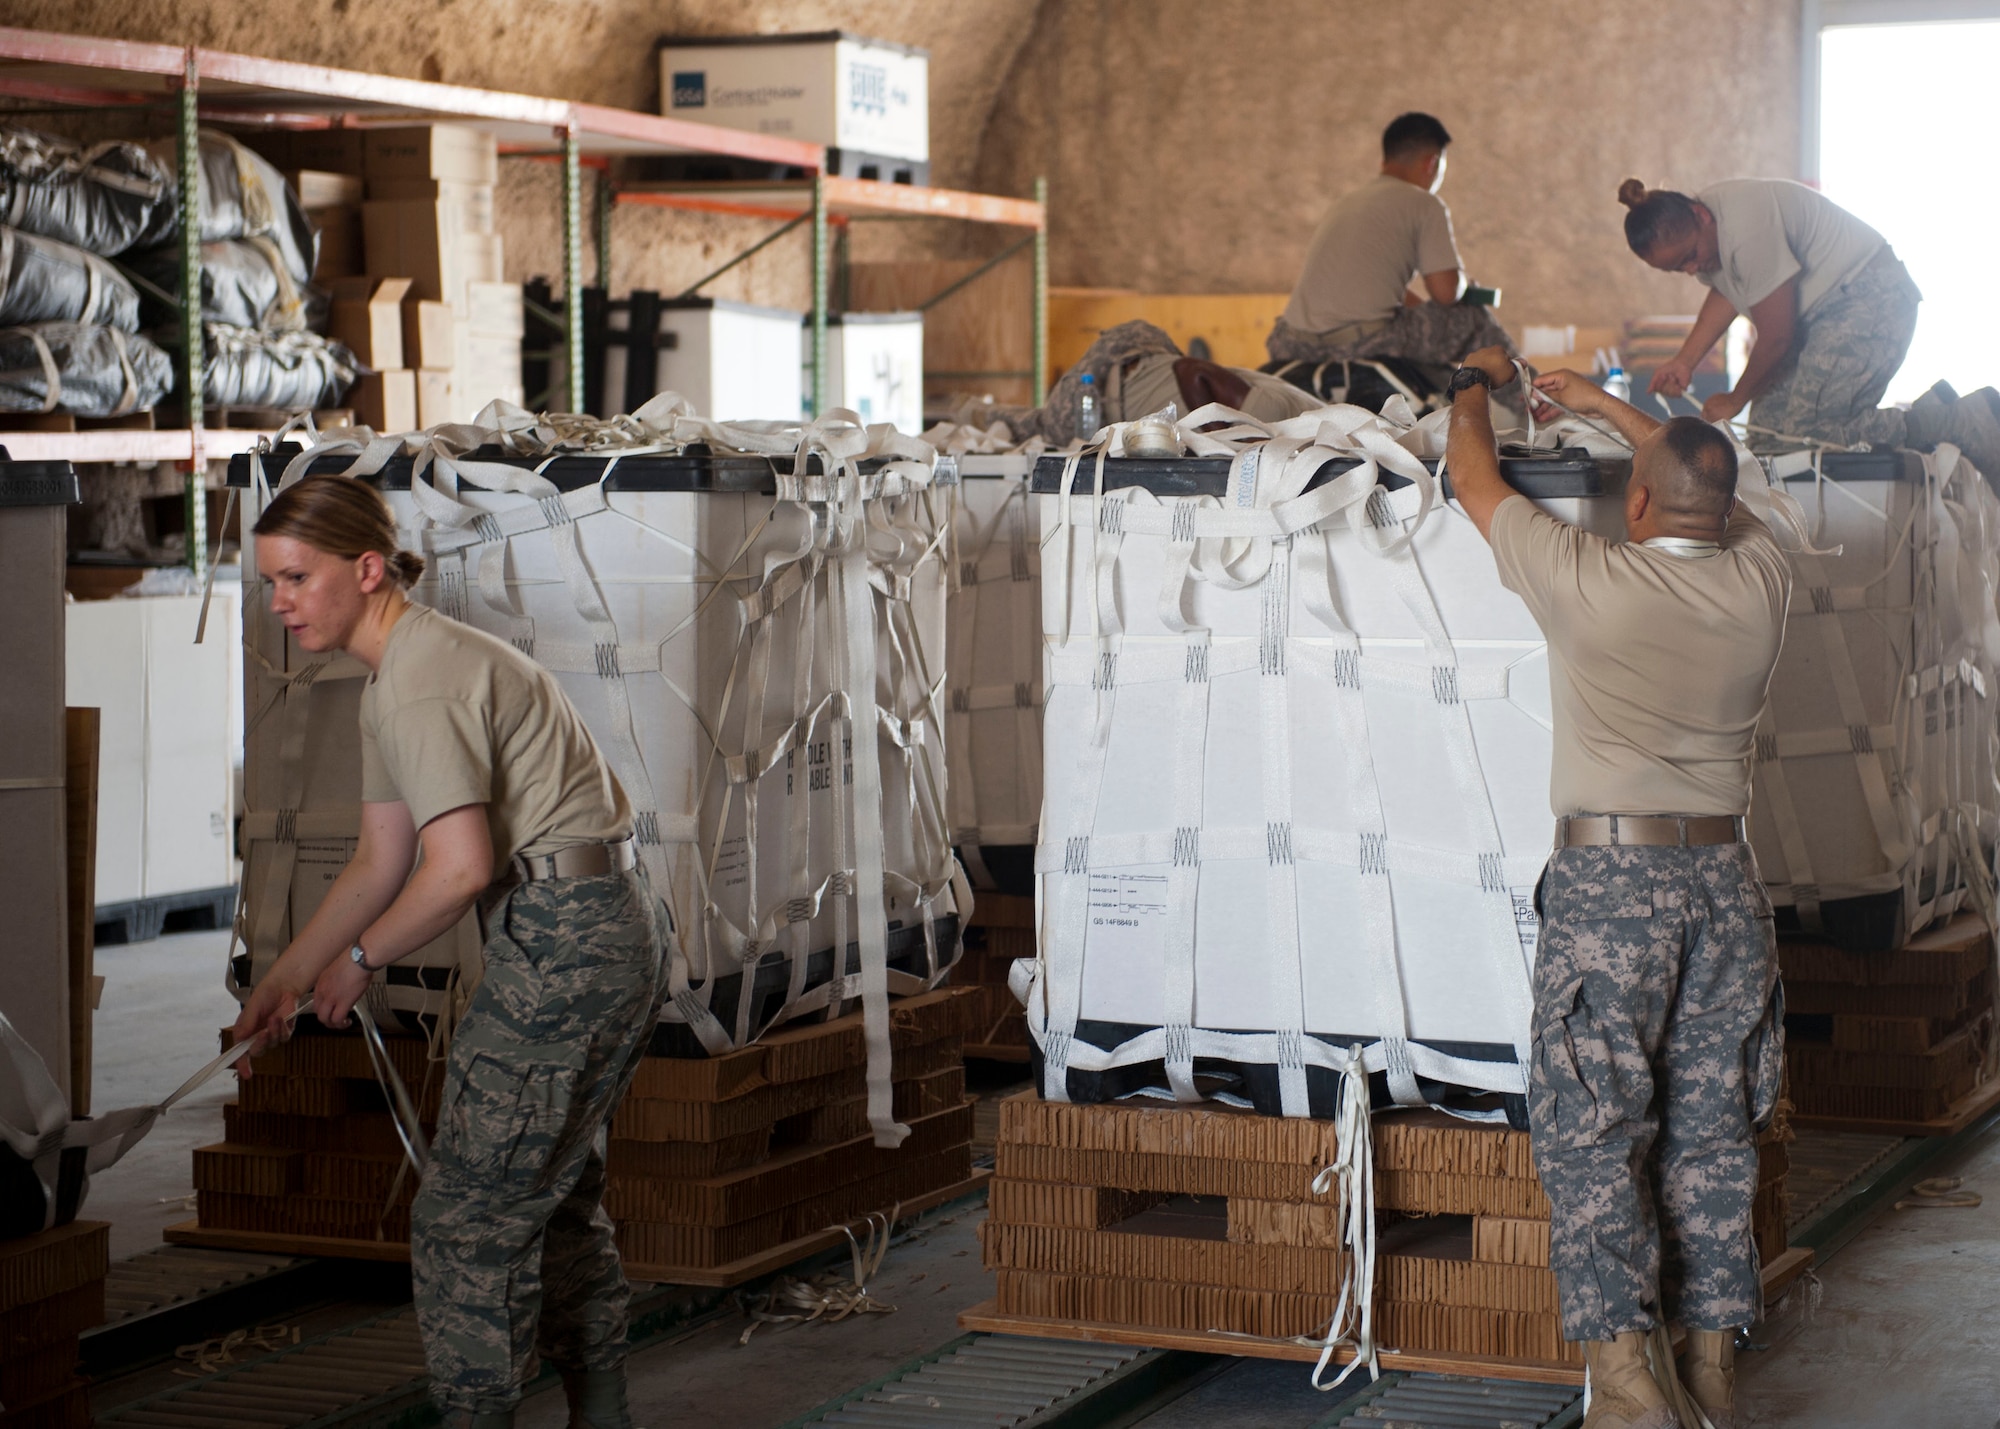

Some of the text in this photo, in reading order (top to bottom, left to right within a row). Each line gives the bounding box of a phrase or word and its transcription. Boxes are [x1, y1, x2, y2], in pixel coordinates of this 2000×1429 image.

[787, 742, 825, 768] HDLE
[787, 767, 831, 796] RABLE
[1093, 917, 1104, 925] GS
[1133, 919, 1139, 927] B
